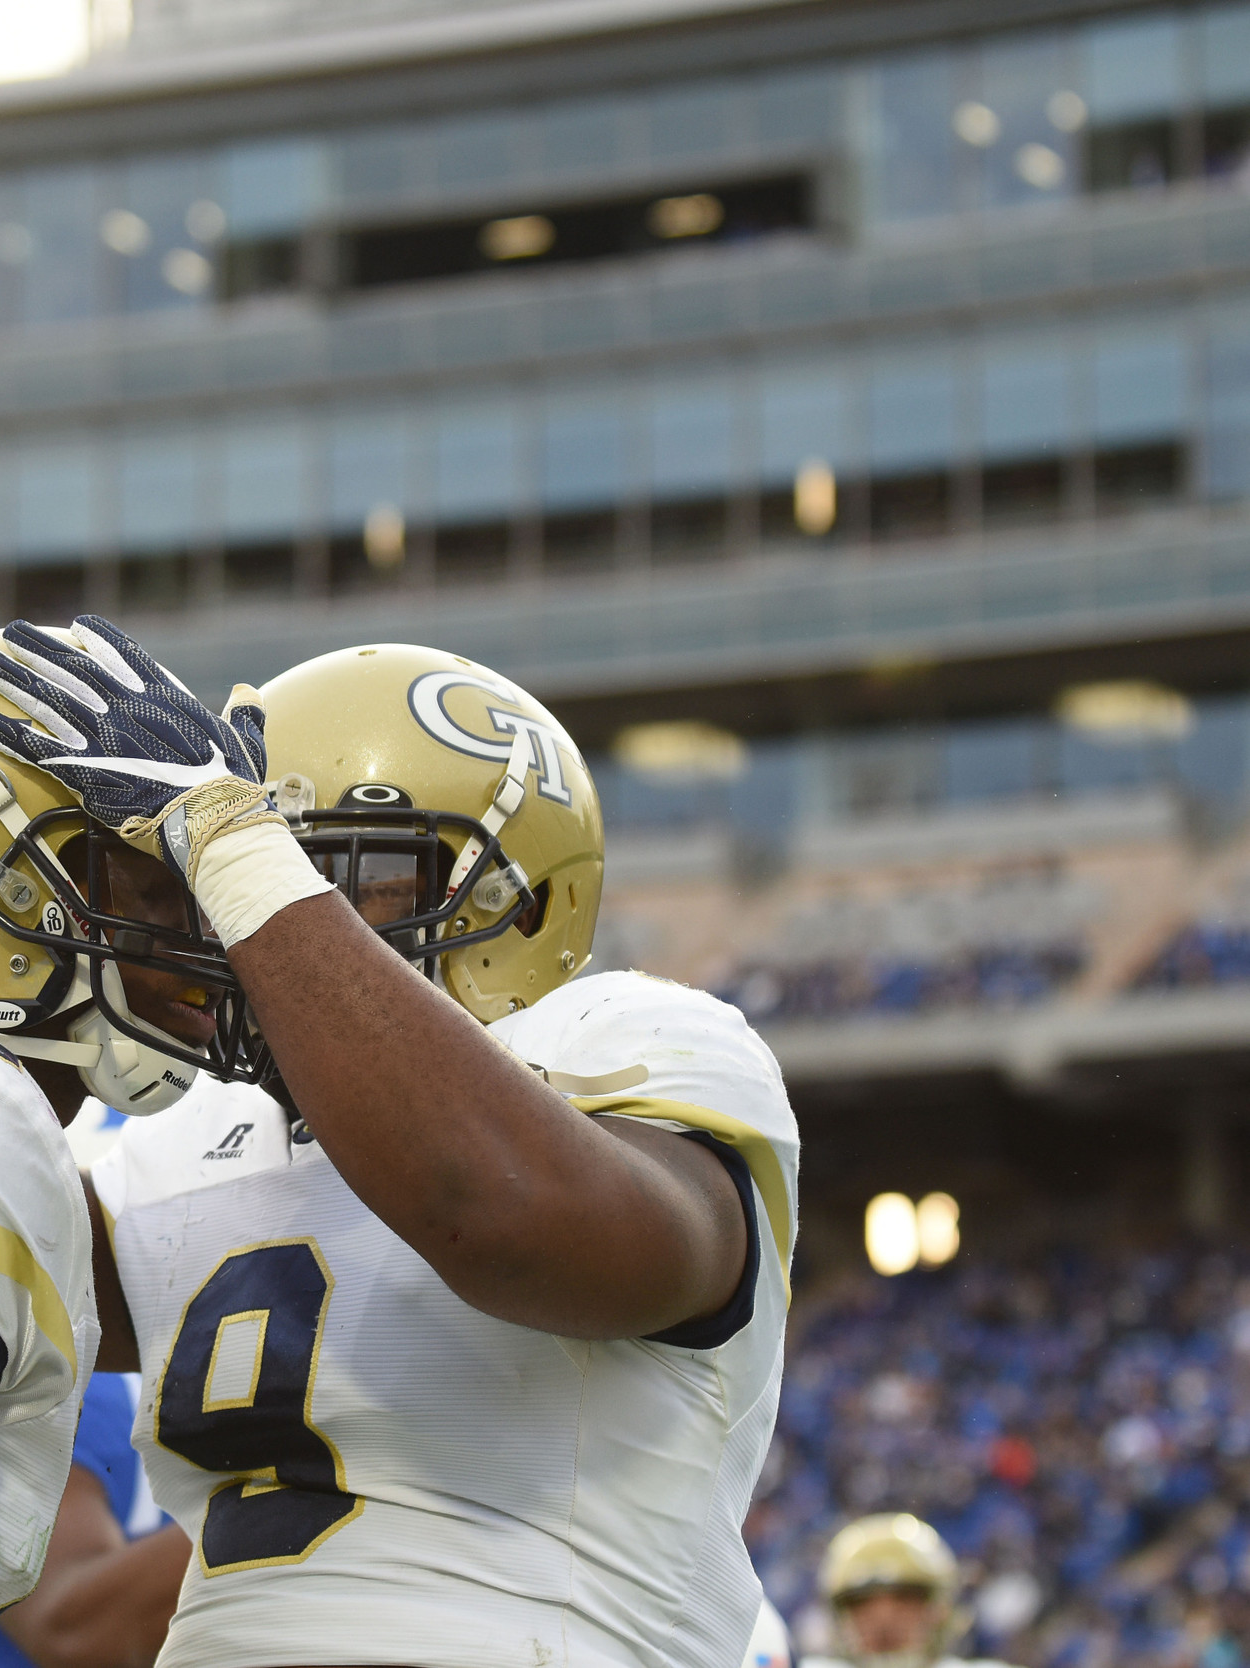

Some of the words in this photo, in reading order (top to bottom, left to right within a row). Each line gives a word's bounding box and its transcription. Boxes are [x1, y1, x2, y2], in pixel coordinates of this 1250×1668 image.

[407, 670, 585, 808] GT
[170, 825, 185, 849] XL
[47, 917, 62, 931] 10
[154, 1235, 366, 1578] 9
